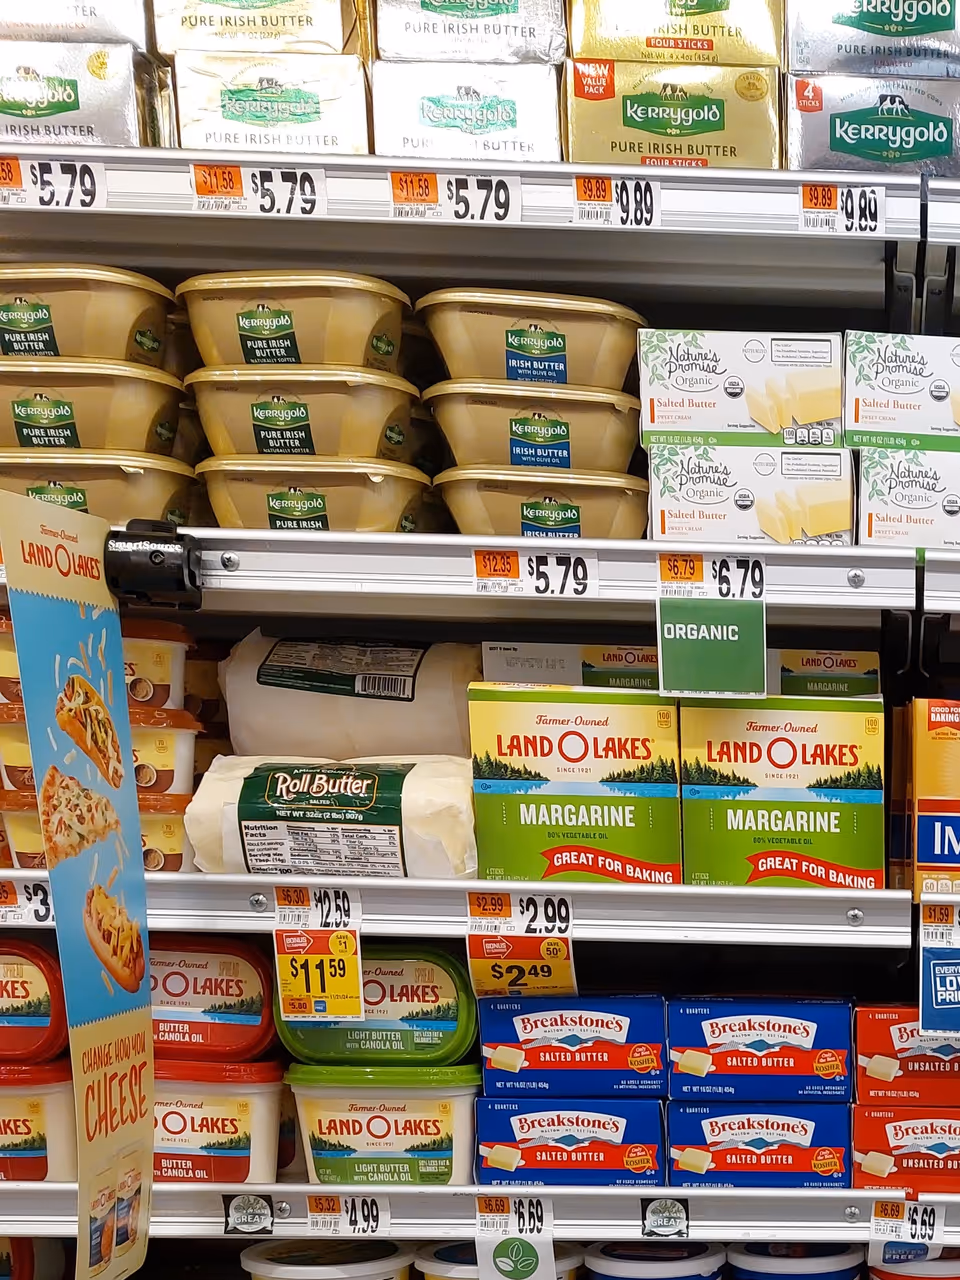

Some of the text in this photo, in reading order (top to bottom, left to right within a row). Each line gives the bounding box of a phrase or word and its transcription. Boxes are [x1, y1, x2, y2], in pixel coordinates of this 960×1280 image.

[181, 15, 315, 28] PURE IRISH BUTTER
[651, 40, 710, 50] FOUR STICKS
[578, 63, 611, 77] NEW
[583, 77, 607, 86] VALUE
[585, 85, 605, 95] PACK
[803, 83, 815, 100] 4
[611, 141, 738, 158] PURE IRISH BUTTER
[30, 162, 97, 208] $5.79
[202, 169, 235, 192] $11.58
[252, 170, 317, 215] $5.79
[582, 179, 607, 200] $9.89
[616, 181, 654, 226] $9.89
[509, 360, 565, 372] IRISH BUTTER
[517, 369, 532, 377] WITH
[675, 375, 714, 389] Organic
[657, 399, 717, 410] Salted Butter
[108, 539, 182, 553] SmartSource
[21, 541, 53, 569] LAND
[74, 558, 101, 581] LAKES
[482, 555, 513, 575] $12.35
[528, 555, 589, 596] $5.79
[664, 623, 740, 643] ORGANIC
[536, 716, 610, 728] Farmer-Owned
[497, 734, 554, 759] LAND
[594, 737, 652, 761] LAKES
[275, 772, 373, 801] Roll Butter
[520, 805, 636, 828] MARGARINE
[244, 824, 279, 832] Nutrition
[245, 831, 267, 839] Facts
[554, 852, 674, 885] GREAT FOR BAKING
[281, 890, 306, 906] $6.30
[520, 896, 571, 934] $2.99
[521, 1014, 625, 1034] Breakstone's
[347, 1031, 402, 1041] LIGHT BUTTER
[82, 1031, 147, 1076] CHANGE HOW YOU
[361, 1040, 389, 1050] CANOLA
[390, 1041, 405, 1050] OIL
[540, 1052, 610, 1063] SALTED BUTTER
[85, 1061, 149, 1143] CHEESE
[314, 1198, 337, 1214] $5.32
[235, 1215, 266, 1225] GREAT
[345, 1199, 380, 1234] $4.99
[514, 1198, 544, 1235] $6.69
